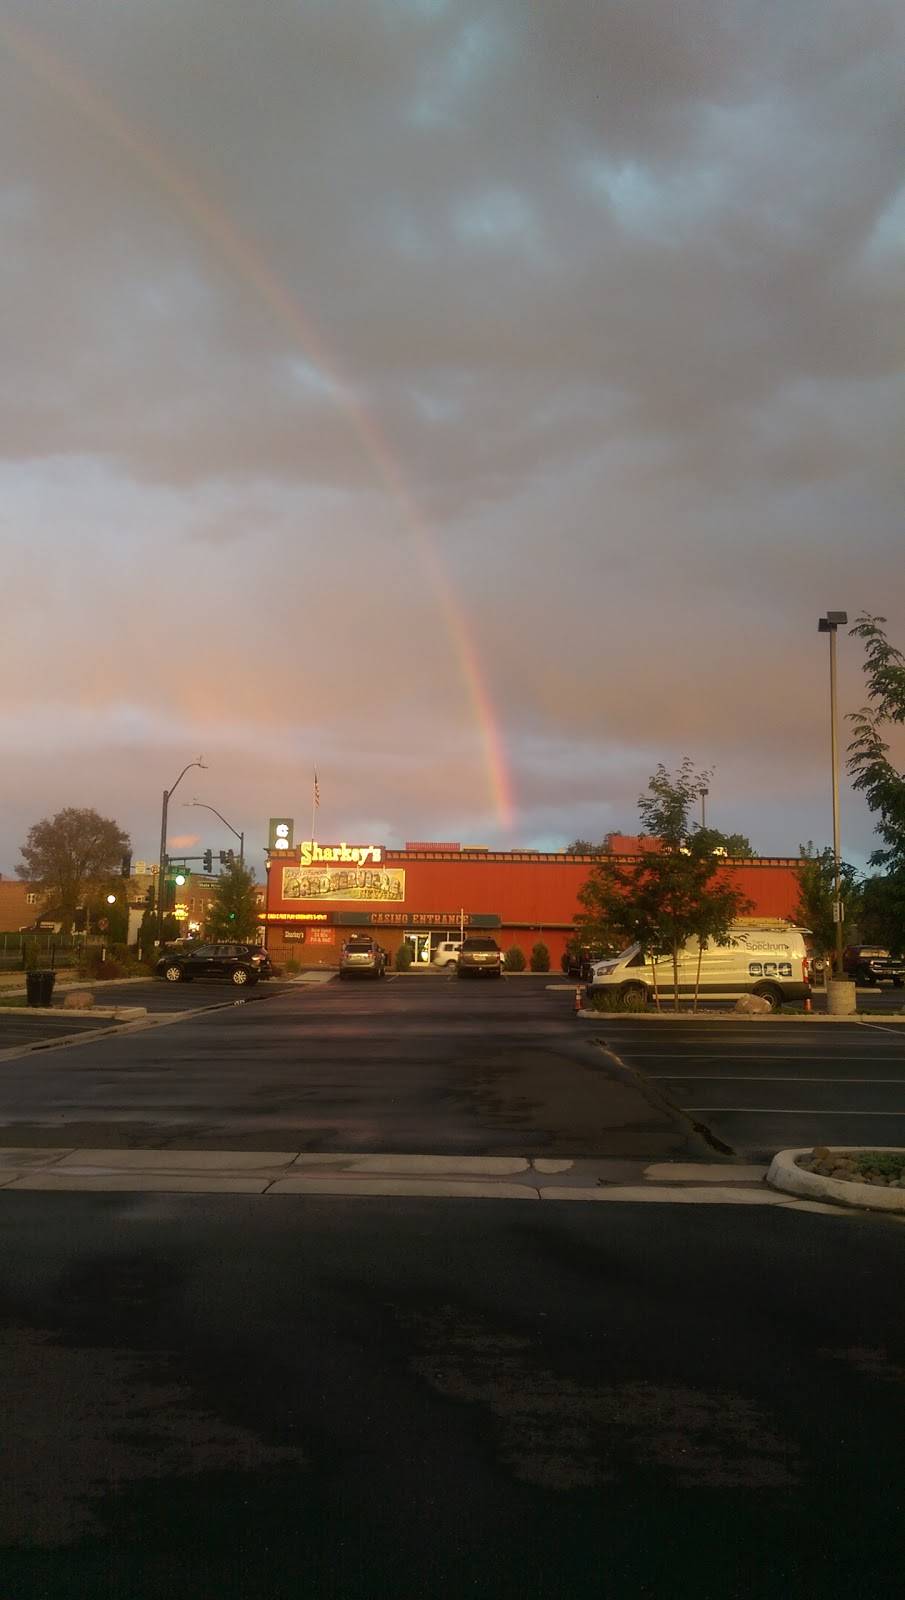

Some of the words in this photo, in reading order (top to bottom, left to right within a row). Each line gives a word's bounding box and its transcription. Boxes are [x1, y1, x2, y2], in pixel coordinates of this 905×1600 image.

[300, 841, 381, 866] Sharkey's
[371, 913, 408, 924] CASINO
[412, 914, 470, 925] ENTRANCE
[746, 943, 786, 951] Spectrum
